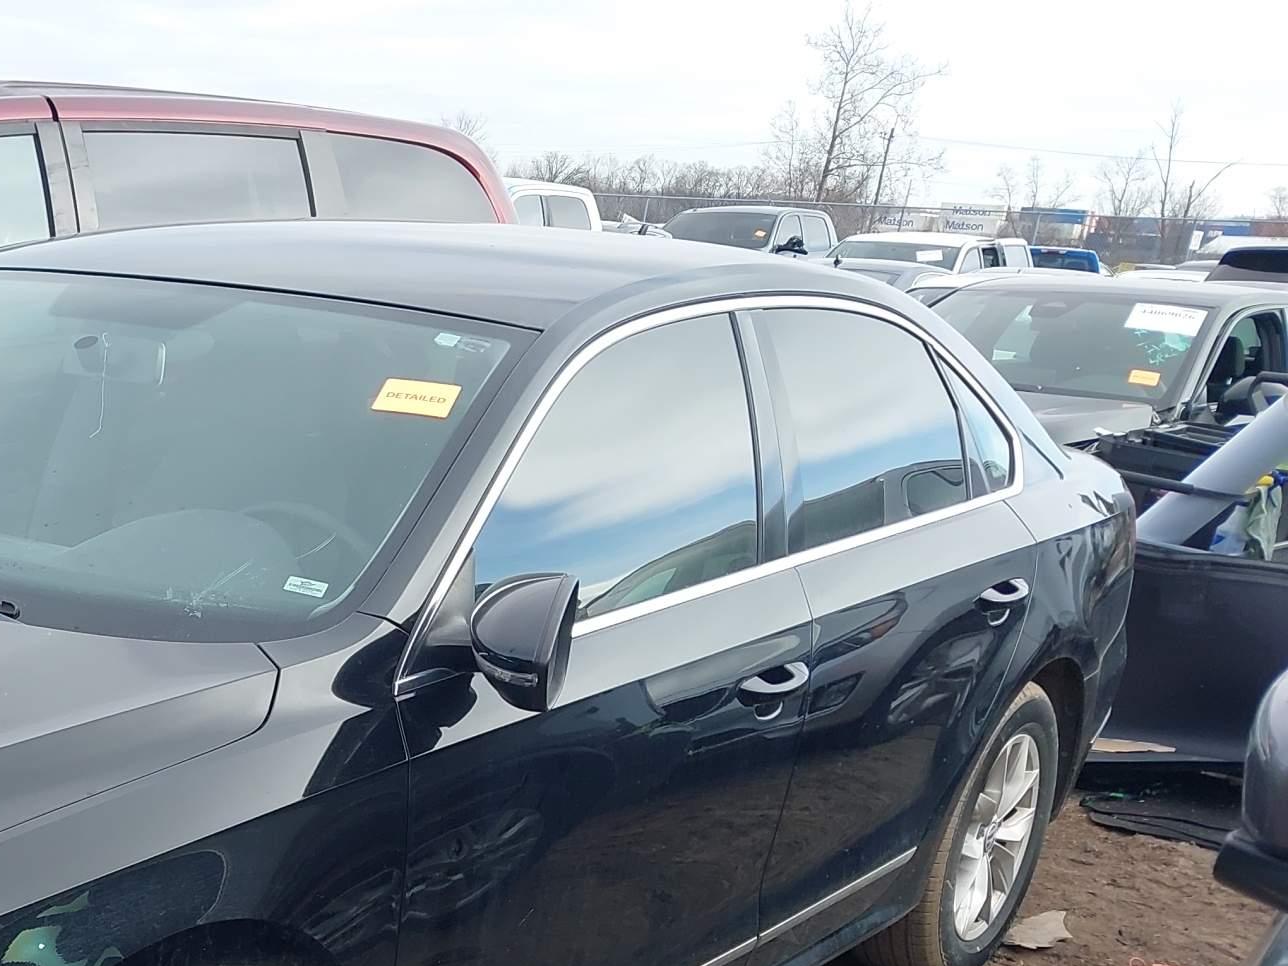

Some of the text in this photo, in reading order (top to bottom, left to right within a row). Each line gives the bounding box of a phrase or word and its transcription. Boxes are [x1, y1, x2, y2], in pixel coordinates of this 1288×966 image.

[952, 205, 991, 217] Matson
[876, 214, 914, 227] Matson
[945, 219, 984, 231] Matson
[386, 391, 447, 404] DETAILED
